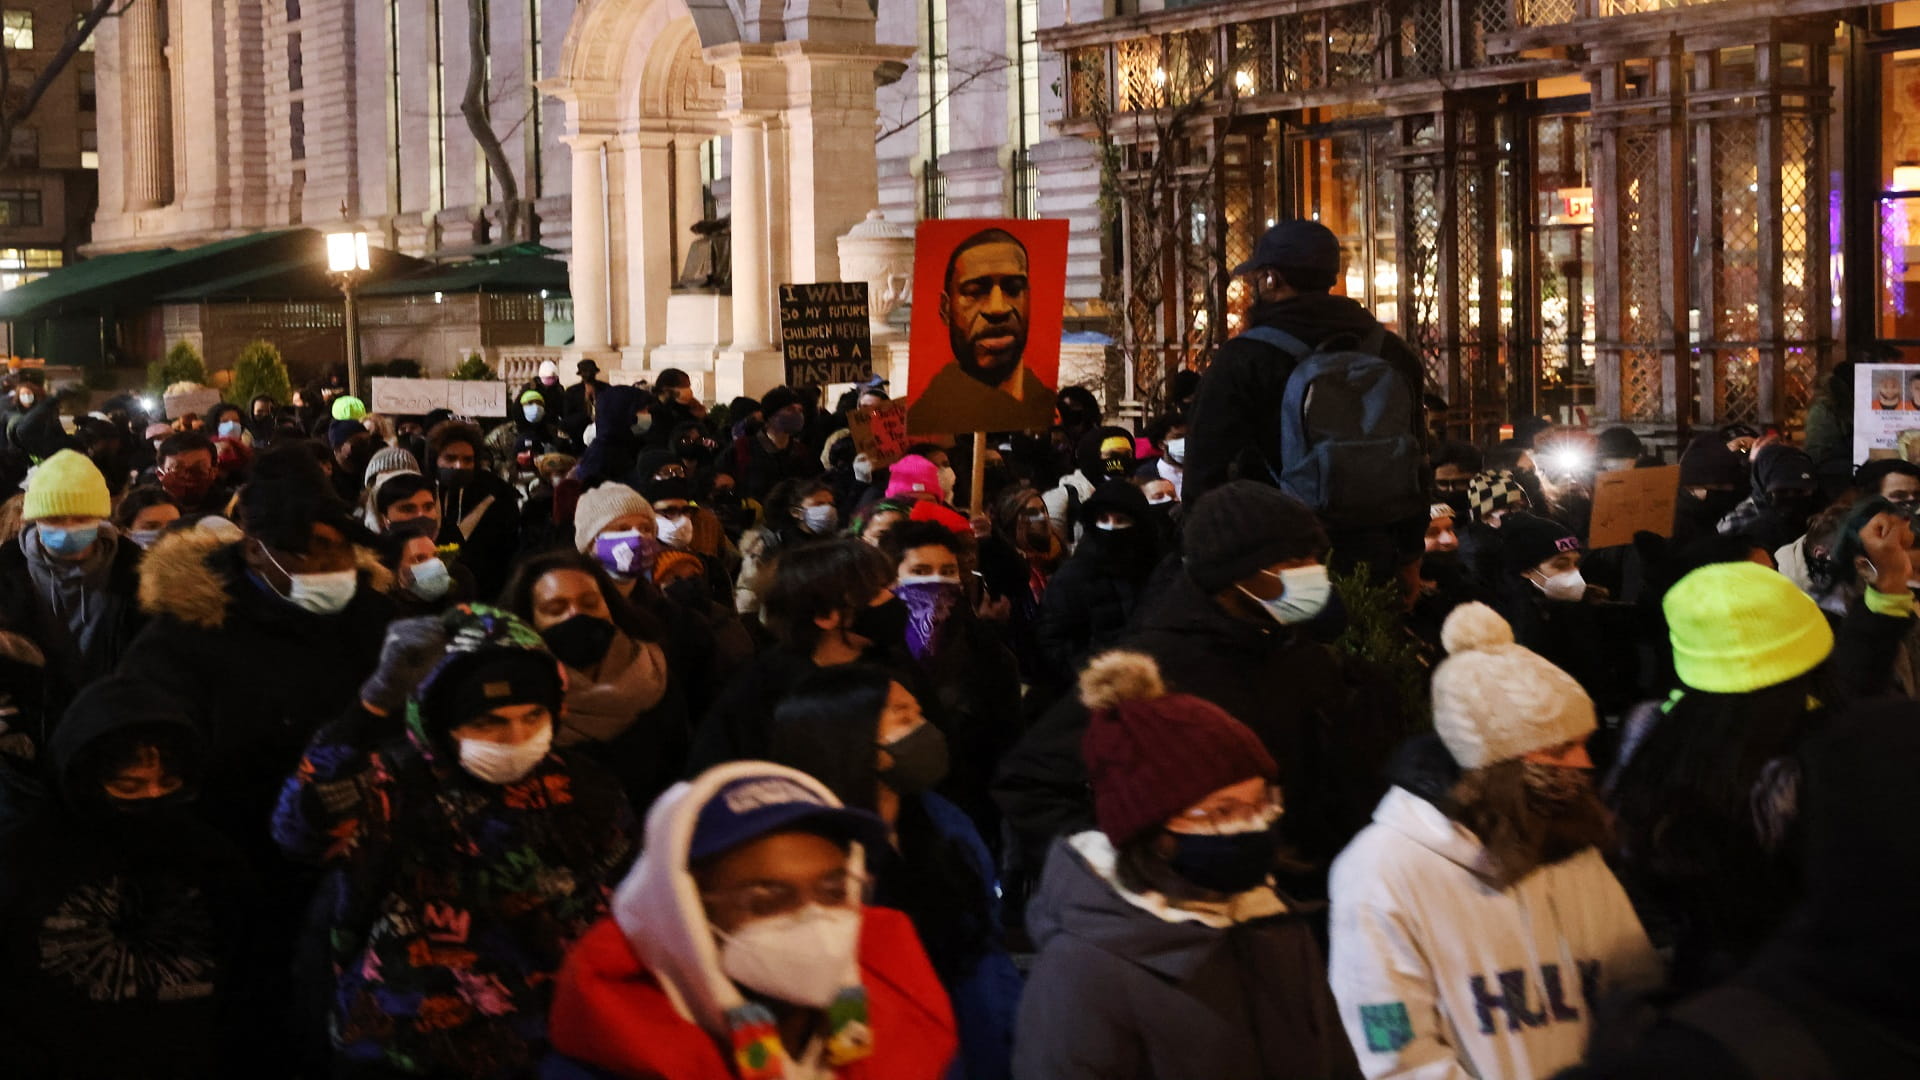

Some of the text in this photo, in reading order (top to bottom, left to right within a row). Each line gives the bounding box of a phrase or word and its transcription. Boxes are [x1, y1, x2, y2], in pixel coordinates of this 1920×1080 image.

[783, 282, 863, 302] I WALK
[781, 304, 868, 321] SO MY FUTURE
[783, 322, 871, 340] CHILDREN NEVER
[788, 343, 862, 360] BECOME A
[792, 362, 873, 388] HASHTAG
